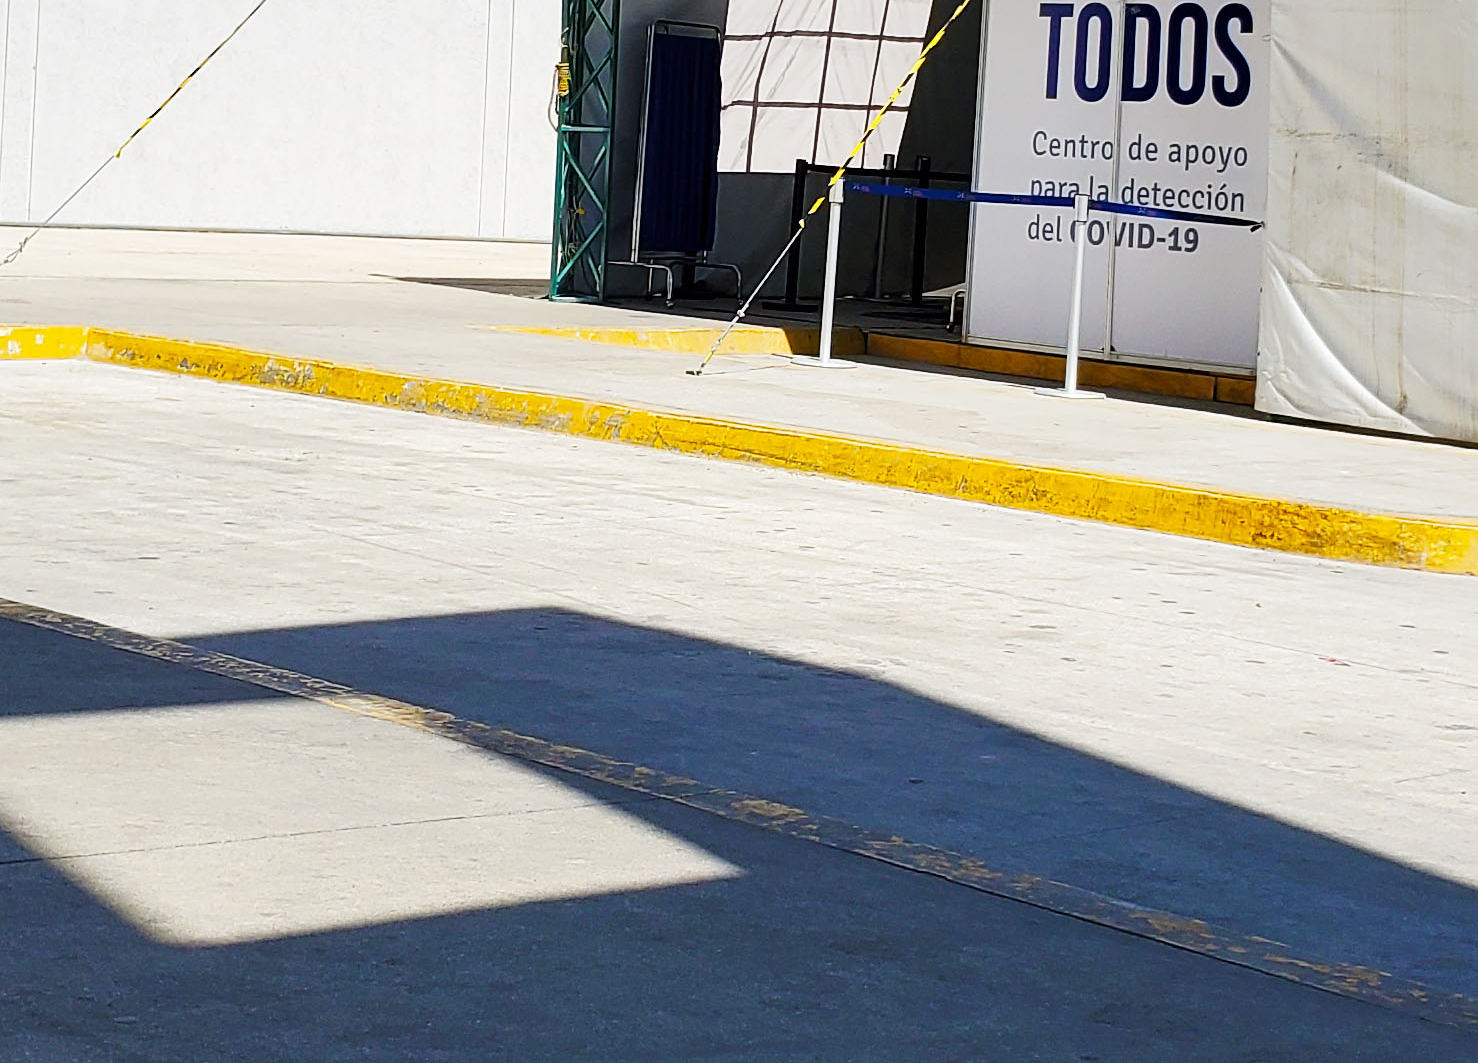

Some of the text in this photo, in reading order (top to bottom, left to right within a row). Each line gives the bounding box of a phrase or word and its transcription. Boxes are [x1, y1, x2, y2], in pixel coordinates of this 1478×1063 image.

[1039, 2, 1255, 107] TODOS
[1032, 130, 1248, 173] Centro de apoyo
[1030, 175, 1246, 213] para la detección
[1027, 213, 1063, 243] del
